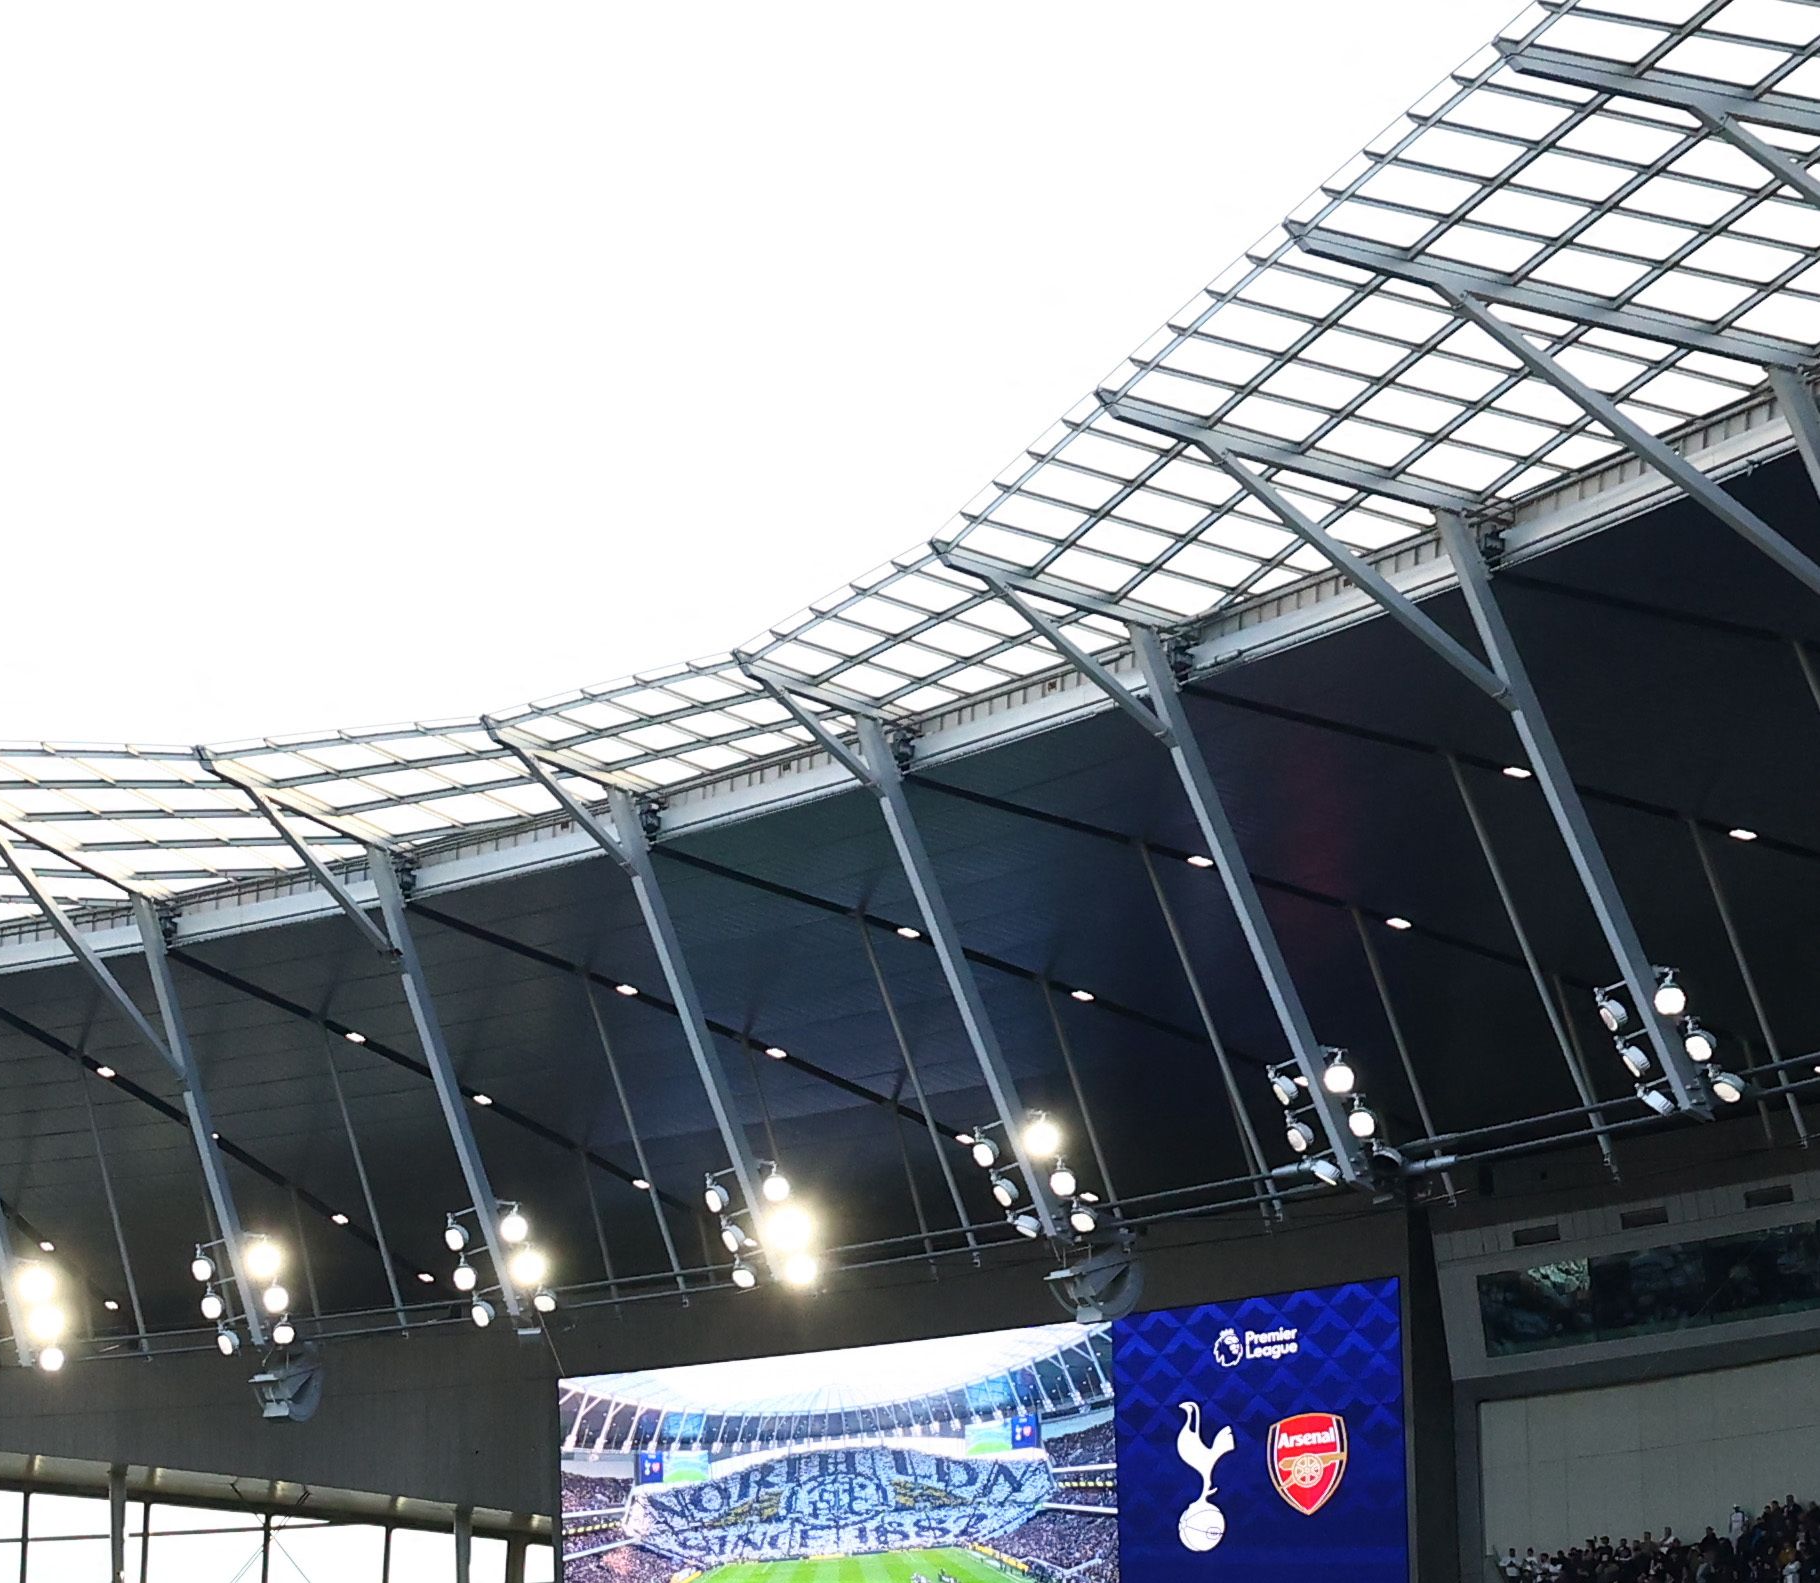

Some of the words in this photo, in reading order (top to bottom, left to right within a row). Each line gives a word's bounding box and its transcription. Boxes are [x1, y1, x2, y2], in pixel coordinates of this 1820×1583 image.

[1245, 1327, 1298, 1344] Premier
[1245, 1342, 1298, 1359] League
[1278, 1427, 1335, 1449] Arsenal
